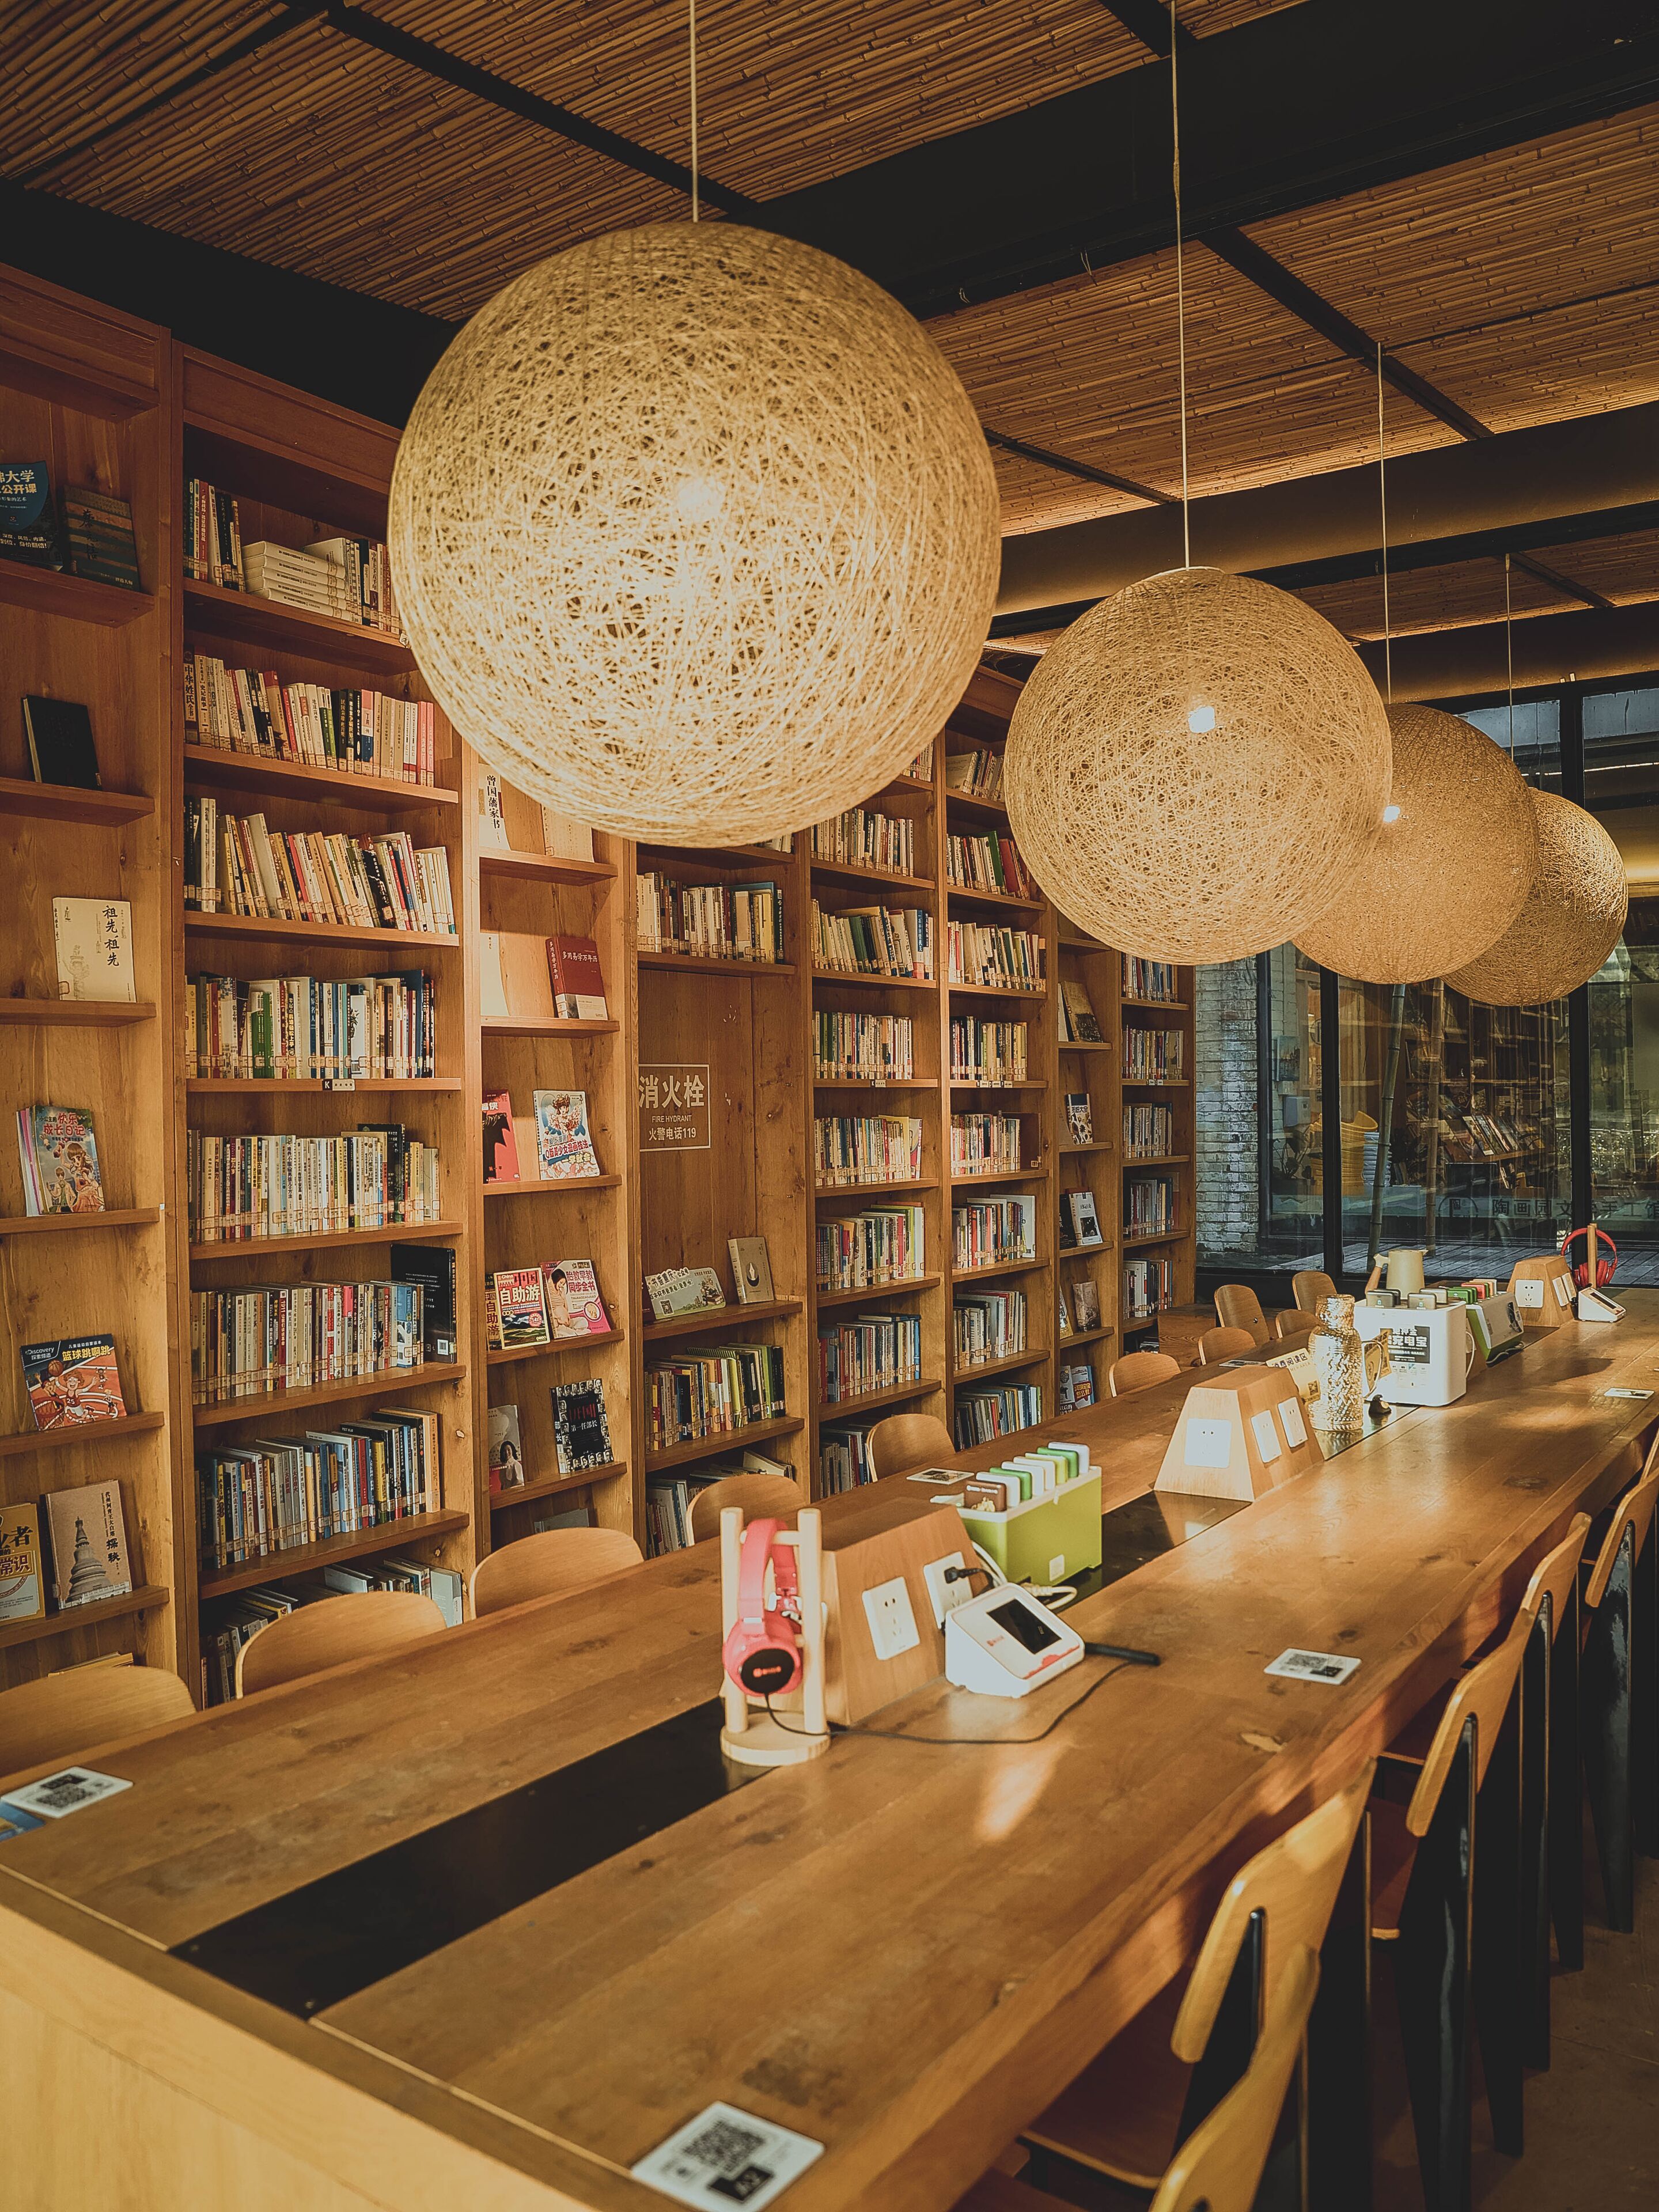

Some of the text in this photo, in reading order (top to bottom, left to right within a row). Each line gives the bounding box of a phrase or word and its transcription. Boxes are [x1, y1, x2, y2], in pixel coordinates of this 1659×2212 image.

[0, 484, 37, 495] 公开课
[487, 775, 501, 829] 曾国藩家书
[562, 950, 598, 963] 多用易学万年历
[639, 1075, 705, 1108] 消火栓
[58, 1112, 77, 1124] 快乐
[43, 1124, 85, 1136] 成长日记
[649, 1127, 696, 1141] 火警电话119
[566, 1270, 594, 1281] 胎教早教
[568, 1281, 596, 1293] 同步全书
[500, 1284, 541, 1304] 自助游
[486, 1301, 499, 1335] 自助游
[62, 1345, 111, 1361] 篮球跳啊跳
